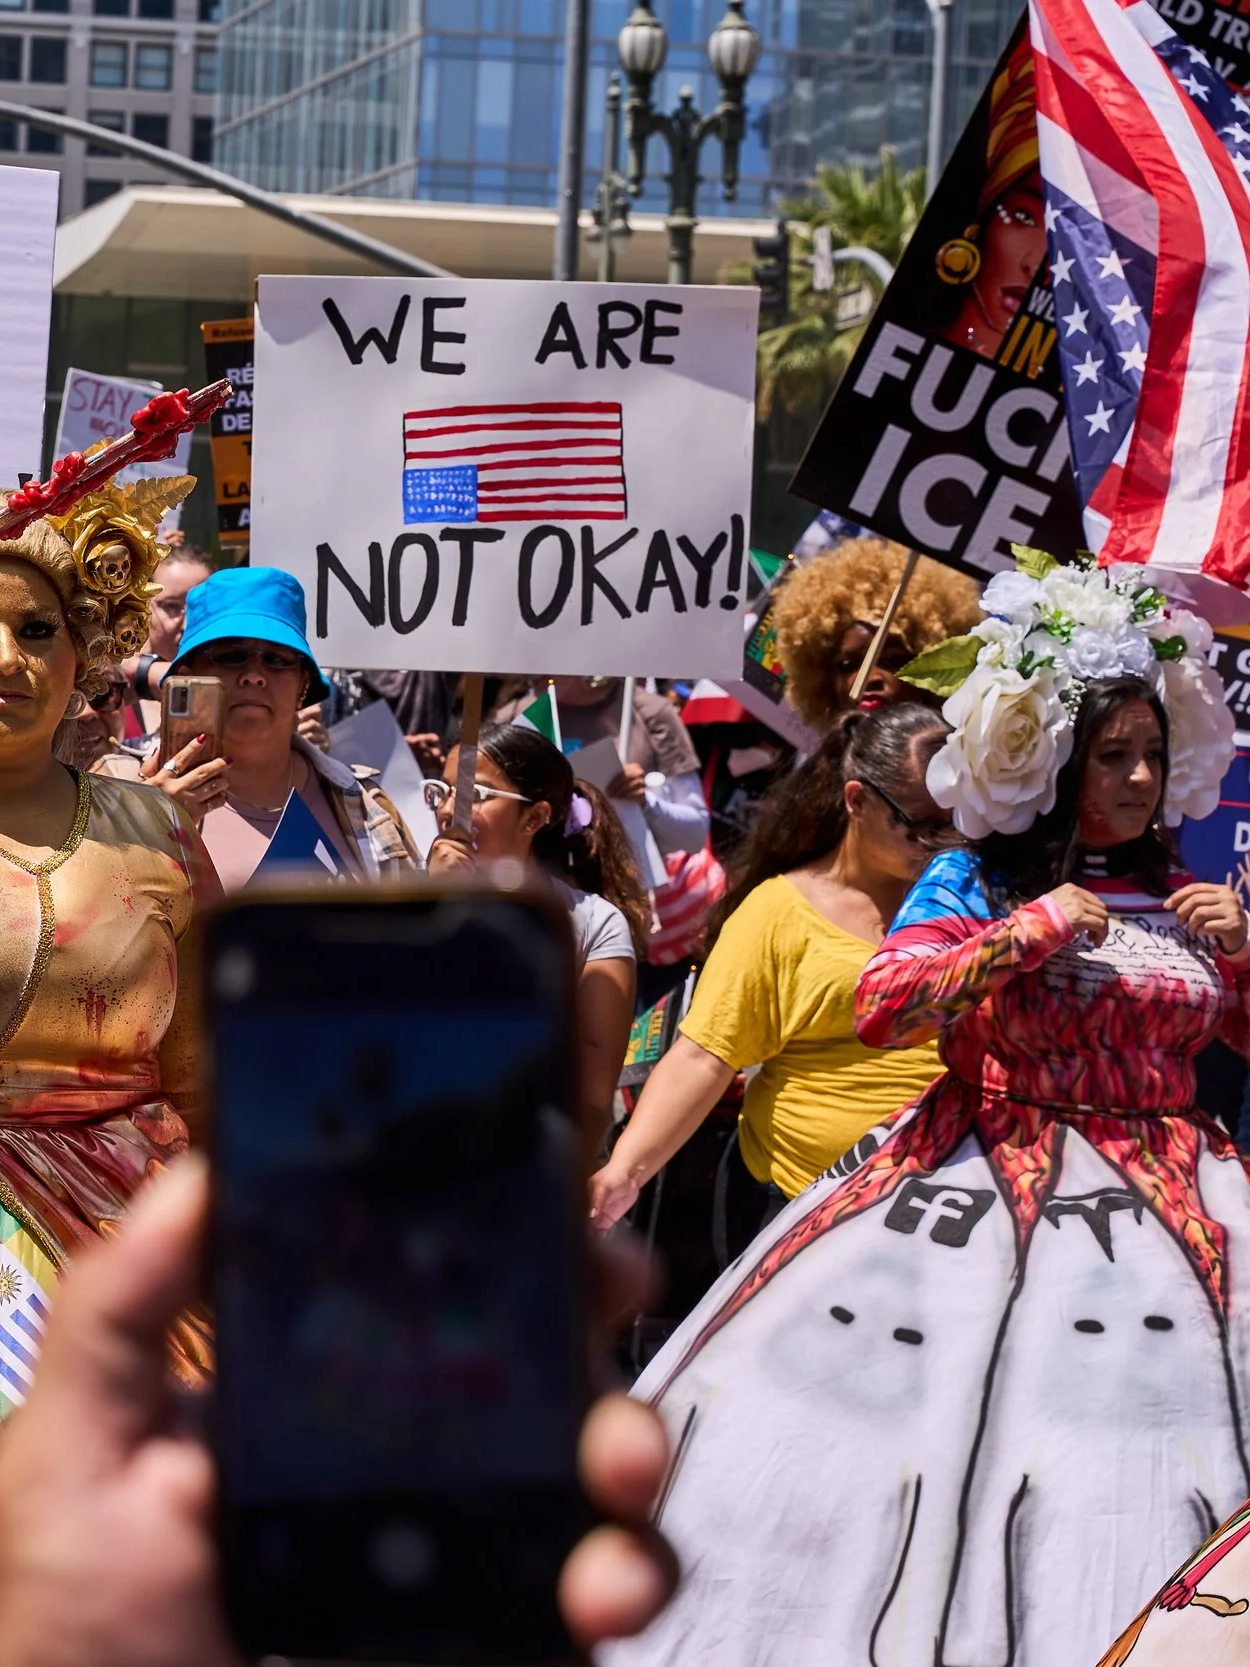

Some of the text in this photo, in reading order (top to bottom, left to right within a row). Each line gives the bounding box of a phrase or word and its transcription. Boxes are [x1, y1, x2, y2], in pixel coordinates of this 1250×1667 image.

[321, 294, 683, 376] WE ARE
[69, 377, 134, 422] STAY
[848, 422, 1052, 575] ICE
[316, 513, 742, 639] NOT OKAY!
